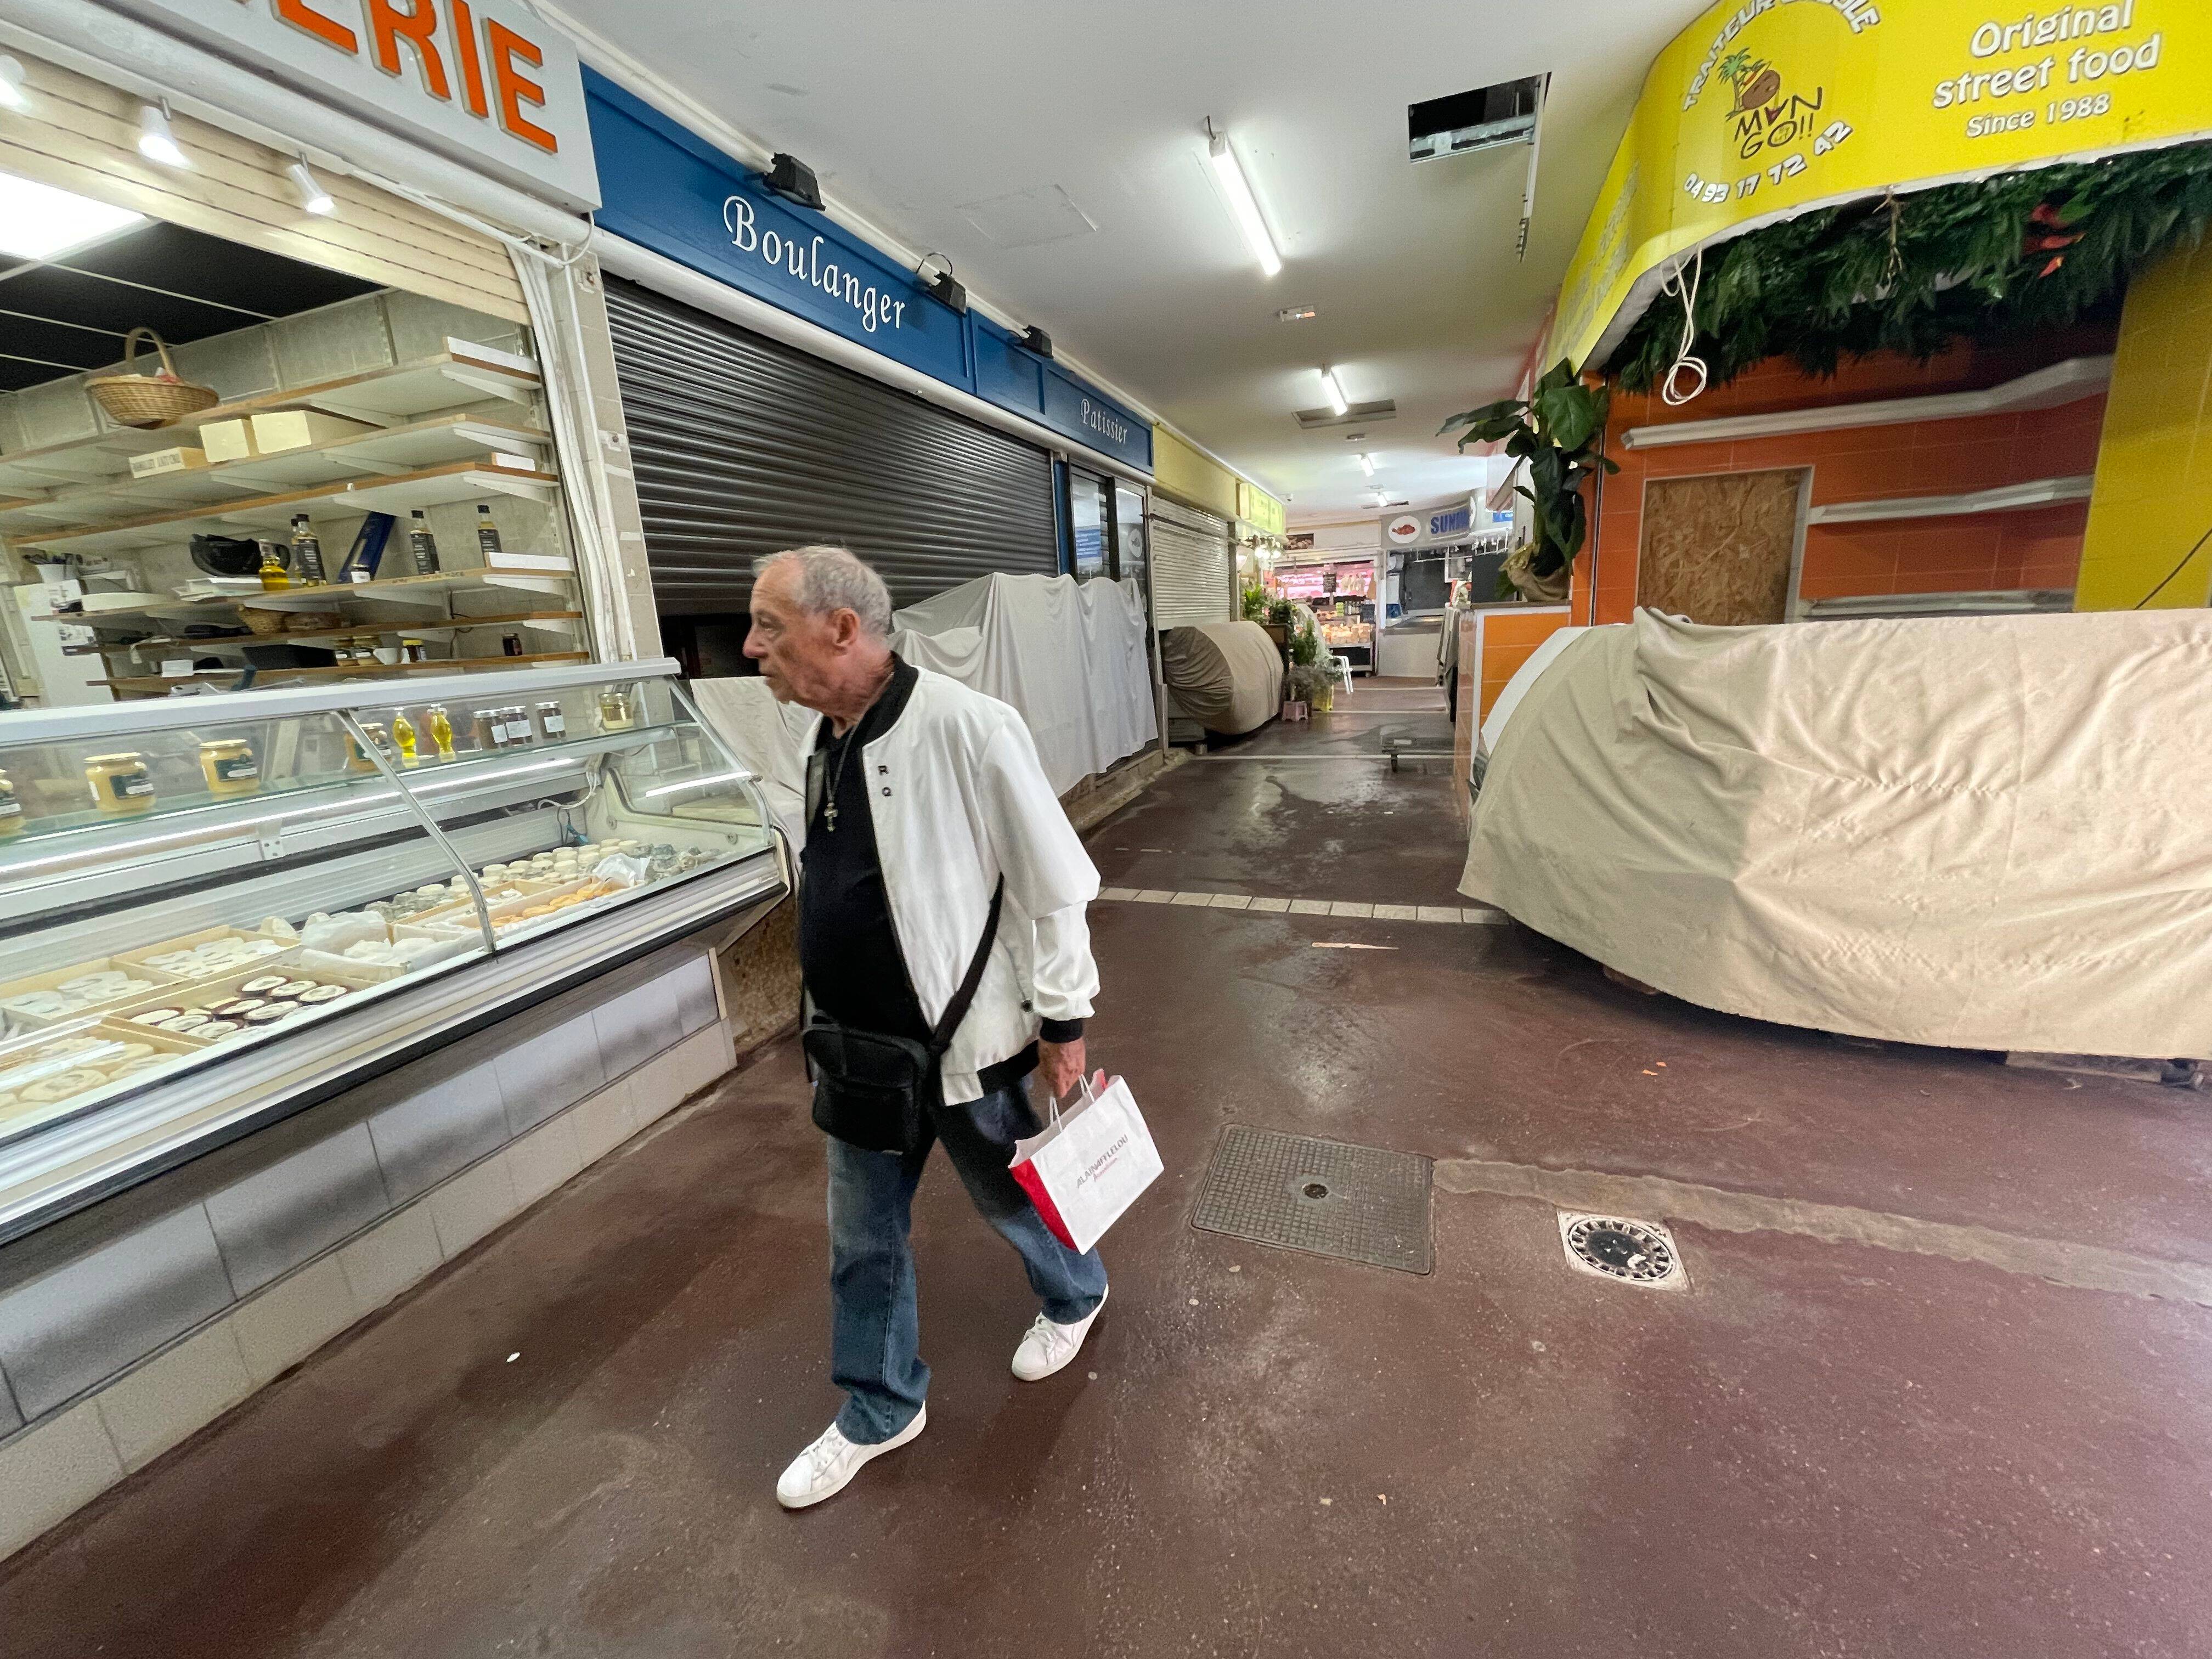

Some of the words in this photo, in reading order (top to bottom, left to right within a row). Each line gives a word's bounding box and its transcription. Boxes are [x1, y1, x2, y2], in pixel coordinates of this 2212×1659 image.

[1970, 0, 2134, 58] Original
[1932, 55, 2055, 109] street
[2068, 32, 2162, 82] food
[1814, 120, 1853, 155] 42
[1966, 110, 2035, 138] Since
[2047, 93, 2111, 124] 1988
[723, 195, 905, 332] Boulanger
[1081, 398, 1127, 444] Patissier
